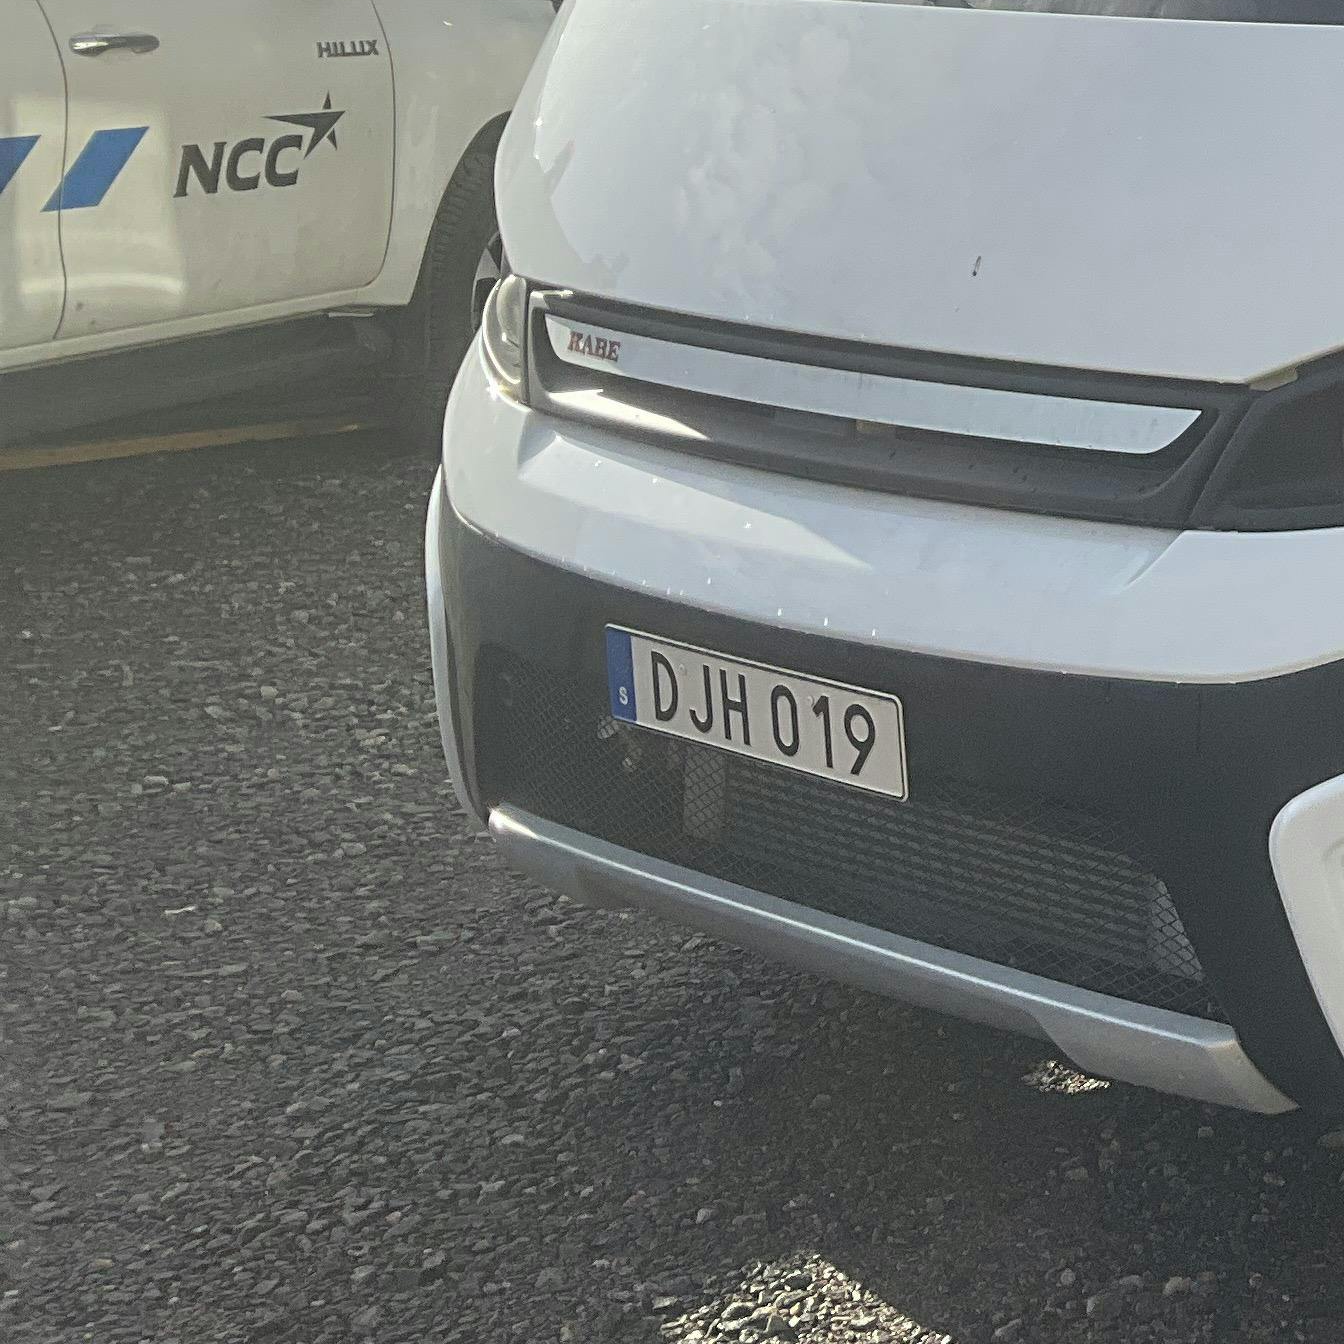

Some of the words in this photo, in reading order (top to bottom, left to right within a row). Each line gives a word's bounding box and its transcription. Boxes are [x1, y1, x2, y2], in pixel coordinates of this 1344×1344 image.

[316, 40, 379, 58] HILUX
[172, 134, 304, 198] NCC
[567, 330, 622, 363] KABE
[618, 686, 630, 706] S
[651, 650, 751, 746] DJH
[771, 684, 876, 776] 019
